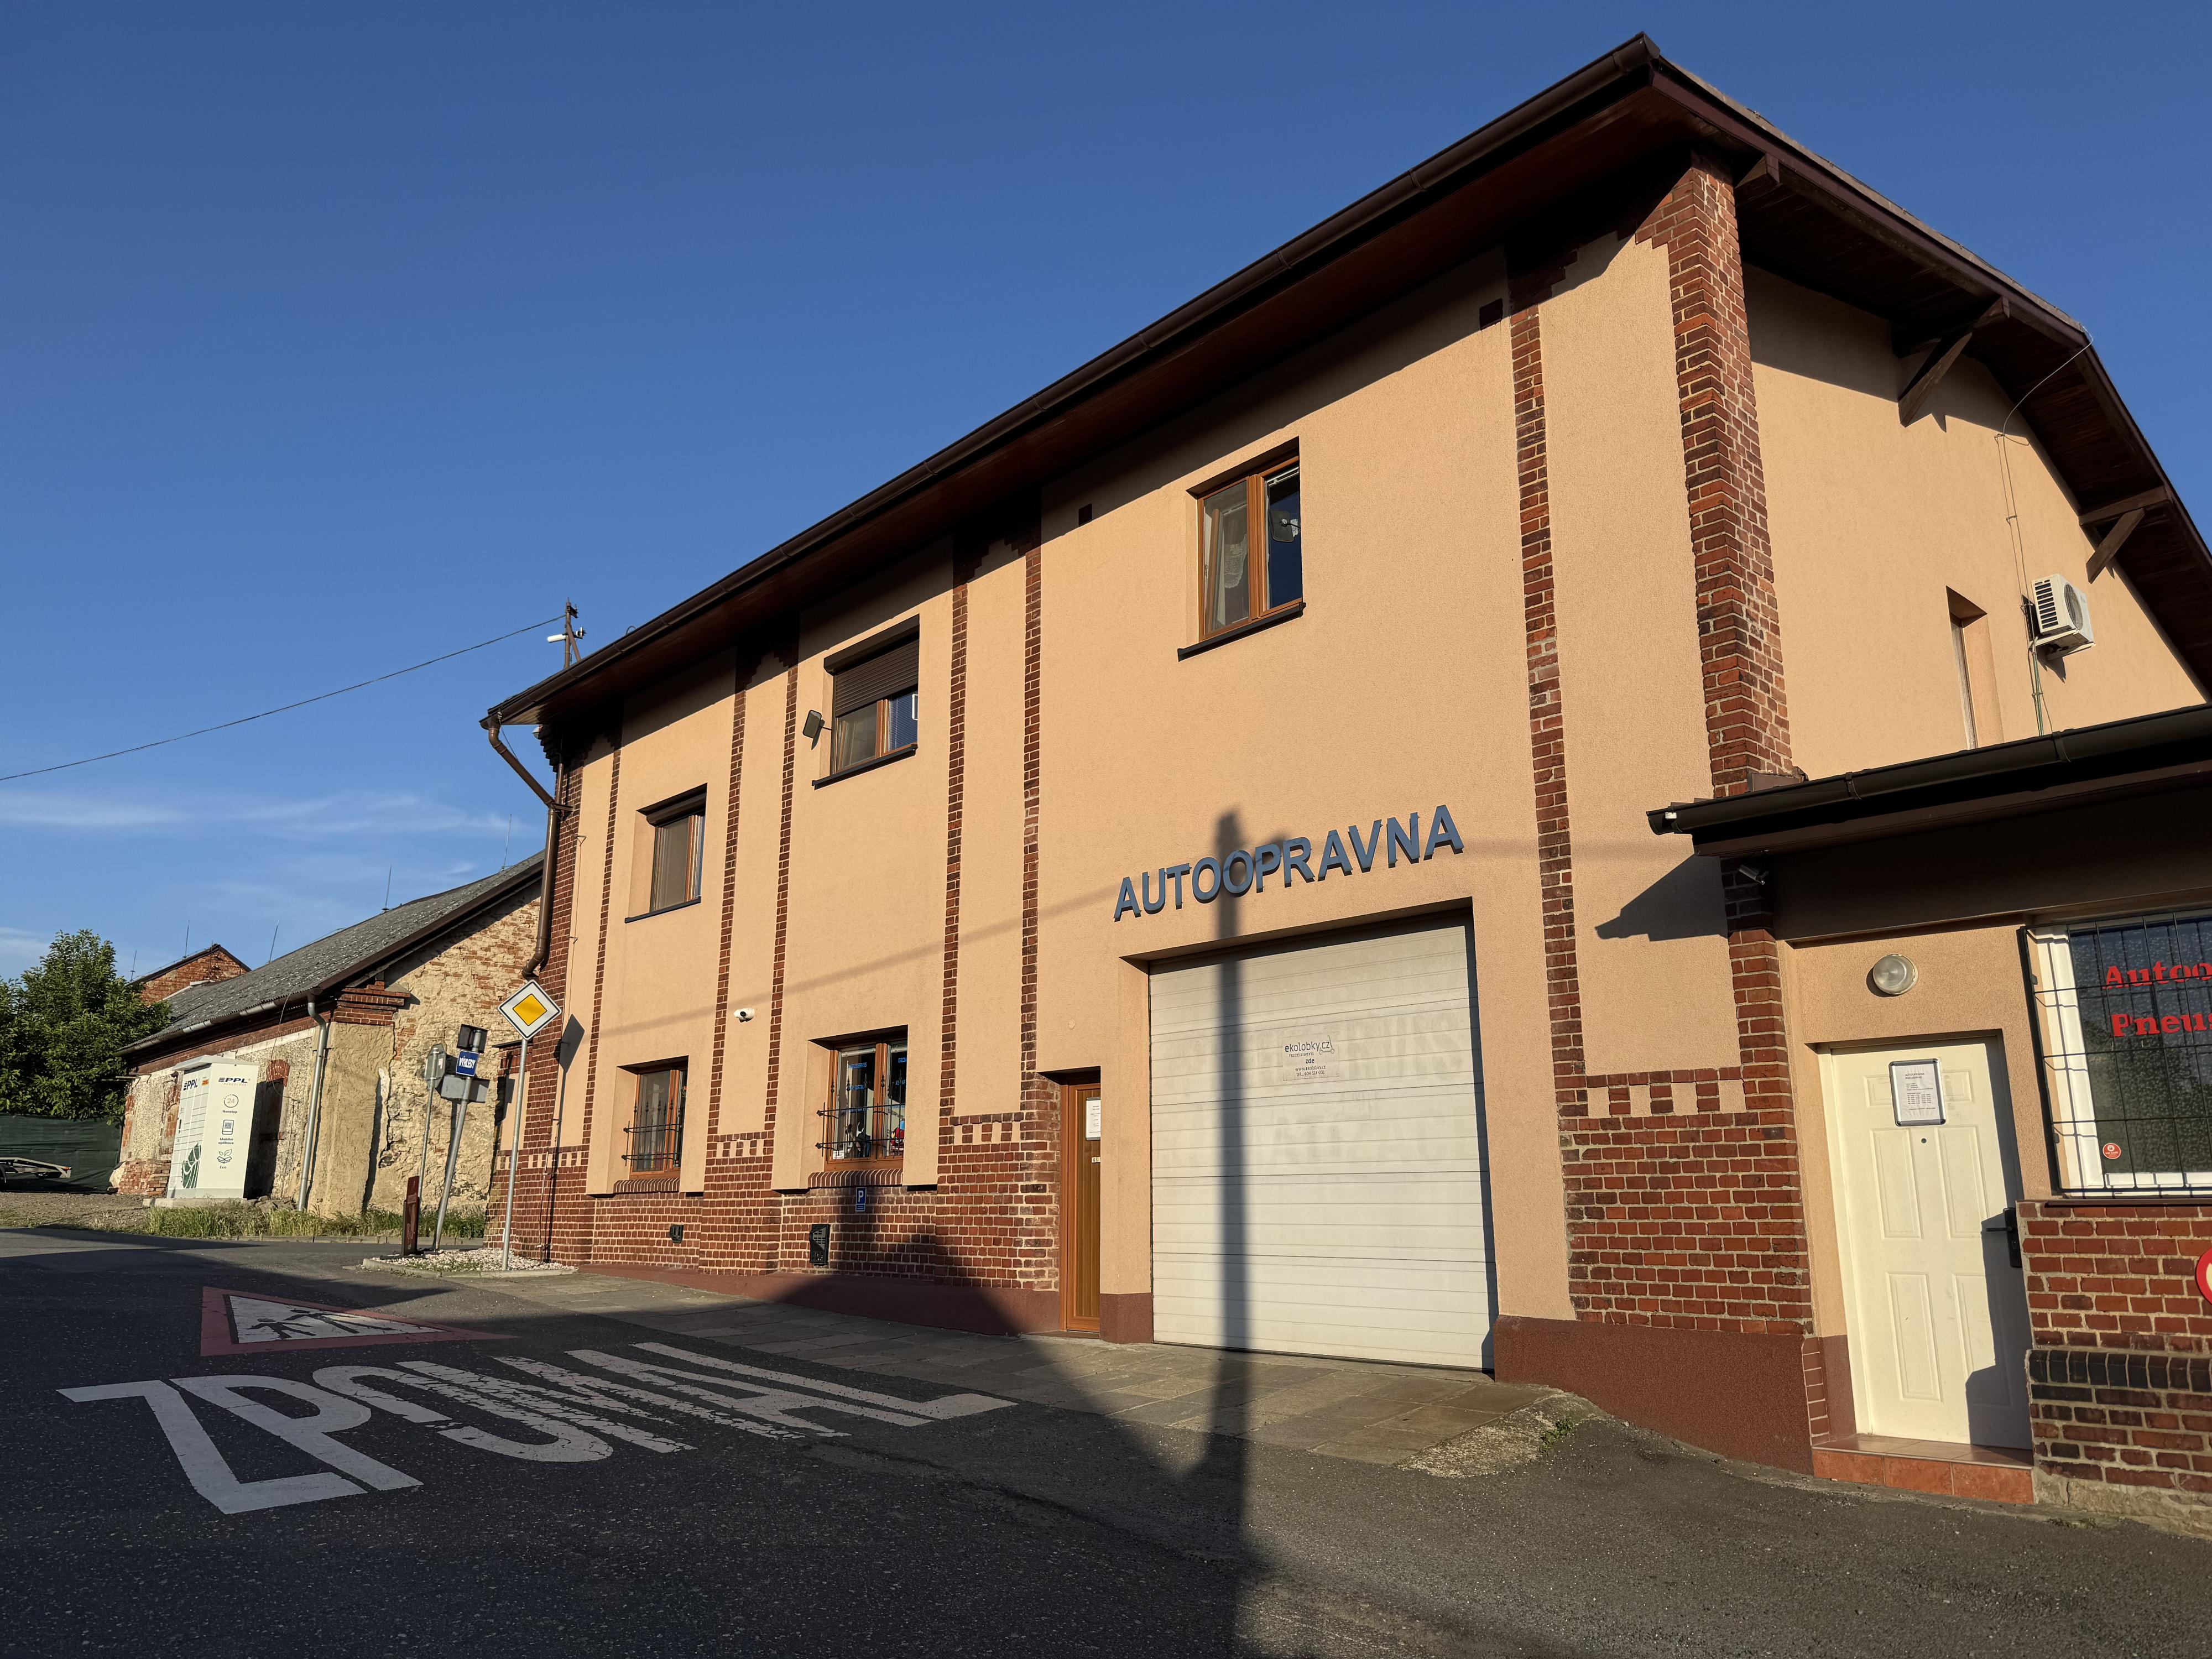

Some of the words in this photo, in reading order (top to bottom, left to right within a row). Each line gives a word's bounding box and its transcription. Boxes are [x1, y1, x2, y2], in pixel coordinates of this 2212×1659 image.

[1113, 804, 1464, 922] AUTOOPRAVNA
[2111, 1013, 2212, 1037] Pneu
[1285, 1041, 1329, 1052] ekolobky.cz
[459, 1056, 476, 1069] VÝHLEDY
[858, 1190, 864, 1202] P
